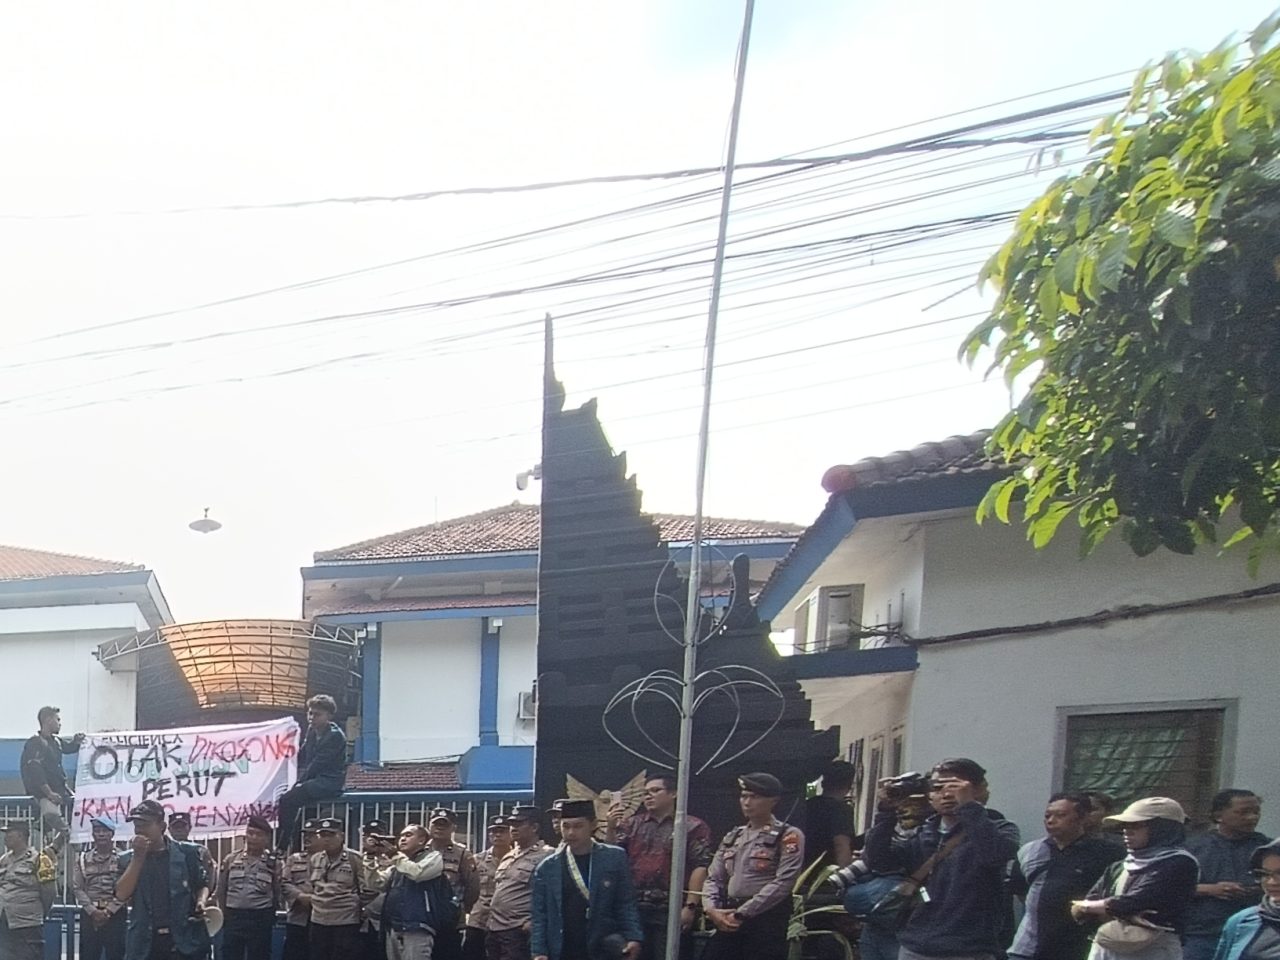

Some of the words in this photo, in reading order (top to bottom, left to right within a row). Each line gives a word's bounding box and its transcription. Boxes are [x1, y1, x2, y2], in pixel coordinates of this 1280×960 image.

[89, 743, 183, 780] OTAK
[188, 729, 298, 764] DIKOSONG
[141, 771, 237, 803] PERUT
